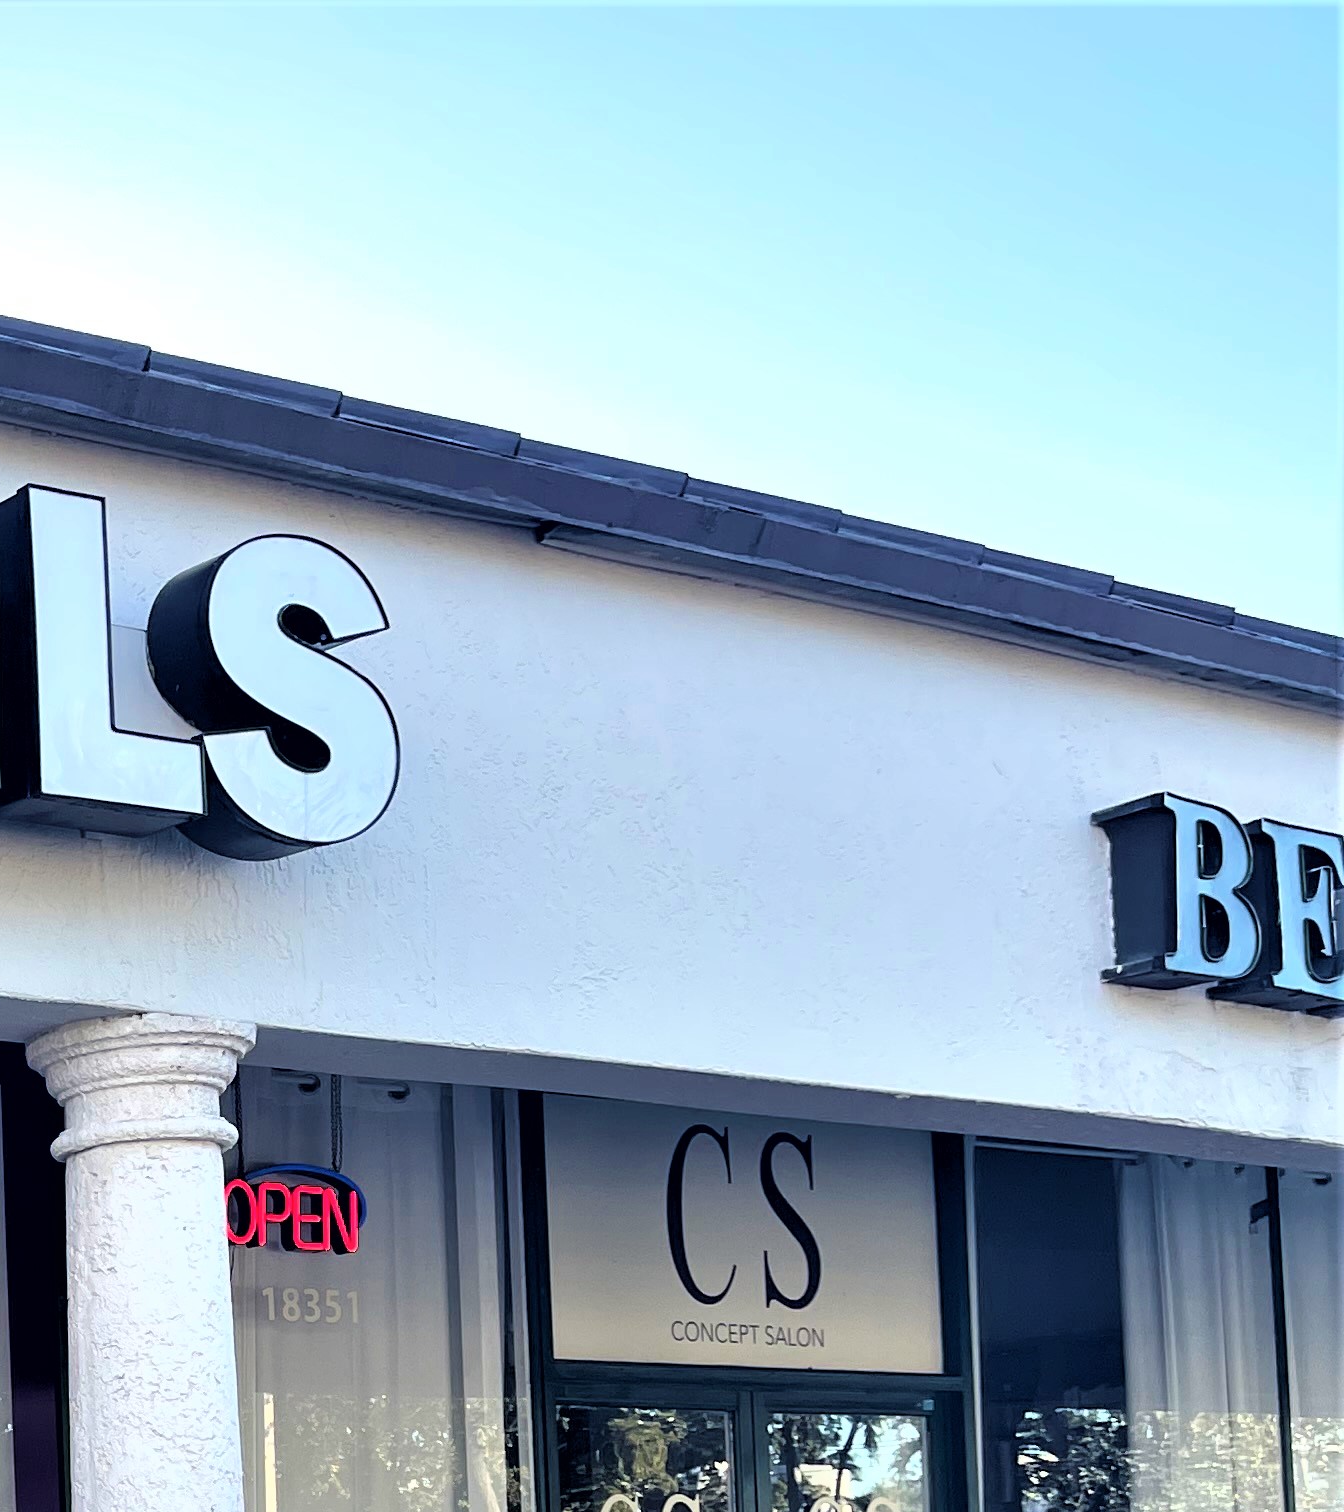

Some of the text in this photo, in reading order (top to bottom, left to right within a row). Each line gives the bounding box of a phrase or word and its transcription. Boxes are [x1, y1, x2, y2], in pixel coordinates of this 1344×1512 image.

[225, 1178, 360, 1253] OPEN
[666, 1123, 822, 1310] CS
[260, 1286, 362, 1324] 18351
[671, 1320, 826, 1348] CONCEPT SALON
